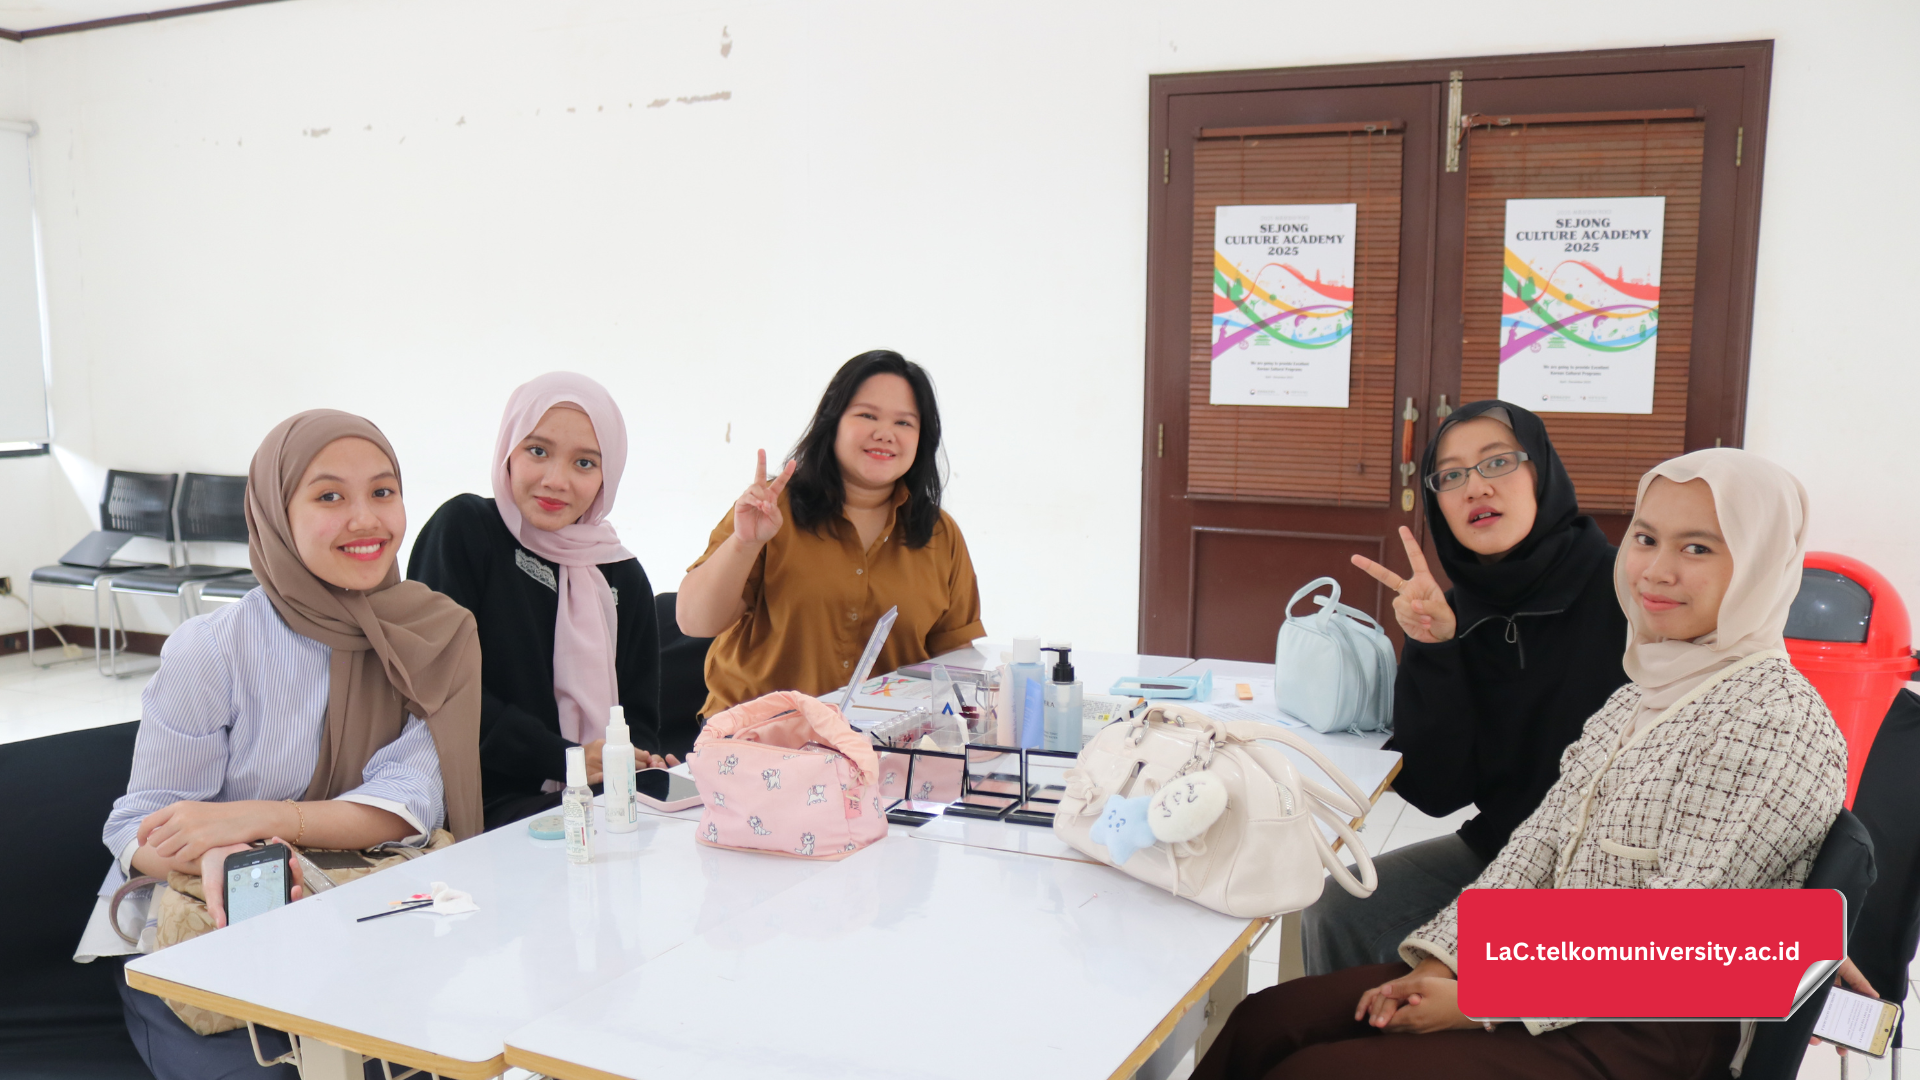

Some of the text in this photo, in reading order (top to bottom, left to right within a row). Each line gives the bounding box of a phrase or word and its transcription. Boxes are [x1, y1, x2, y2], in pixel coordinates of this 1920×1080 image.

[1259, 223, 1309, 234] SEJONG
[1555, 218, 1611, 229] SEJONG
[1224, 234, 1345, 245] CULTURE ACADEMY
[1516, 229, 1652, 242] CULTURE ACADEMY
[1267, 246, 1300, 256] 2025
[1564, 242, 1600, 253] 2025
